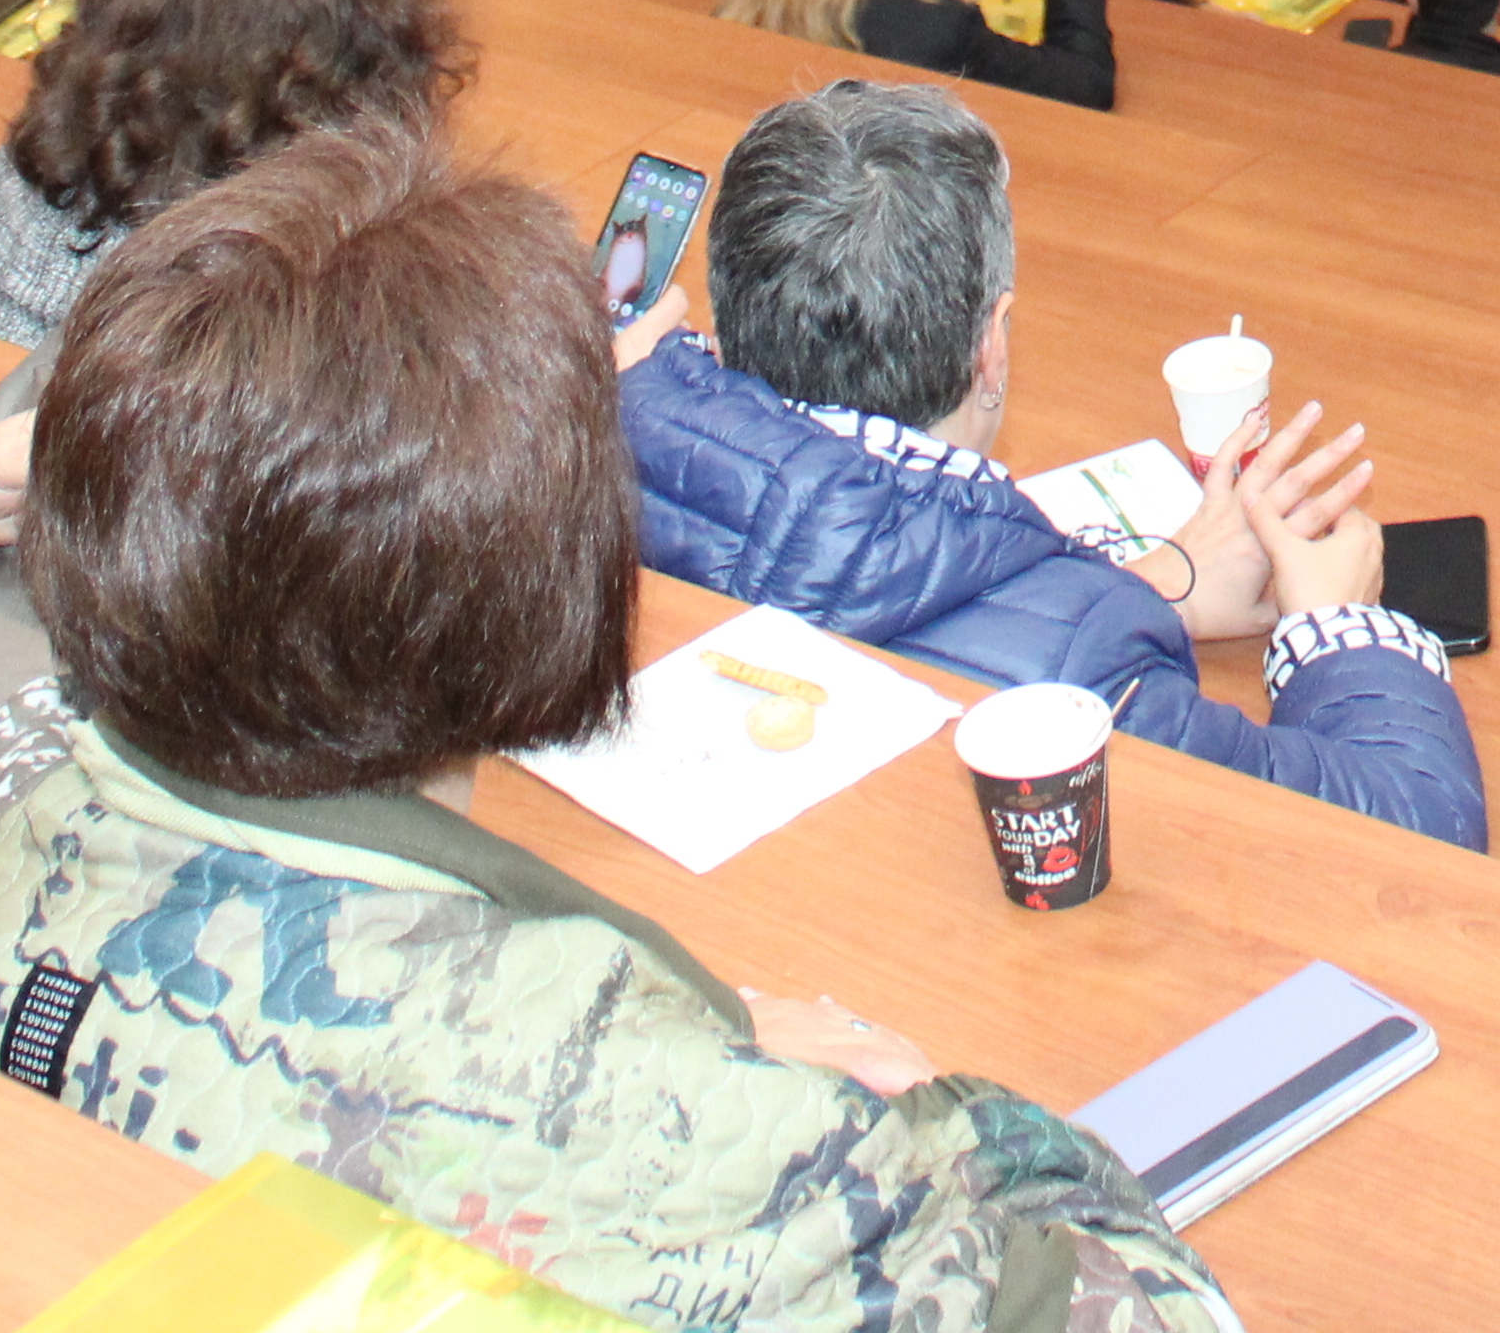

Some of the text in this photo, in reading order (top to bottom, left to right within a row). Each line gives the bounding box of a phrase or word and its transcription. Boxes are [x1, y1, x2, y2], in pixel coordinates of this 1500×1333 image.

[990, 801, 1079, 832] START
[995, 818, 1081, 848] YOUR DAY
[1002, 841, 1032, 854] with
[1014, 867, 1077, 886] coffee
[30, 984, 75, 1008] COUTURE
[20, 1011, 66, 1034] COUTURE
[11, 1037, 54, 1060] COUTURE
[8, 1064, 48, 1088] COUTURE
